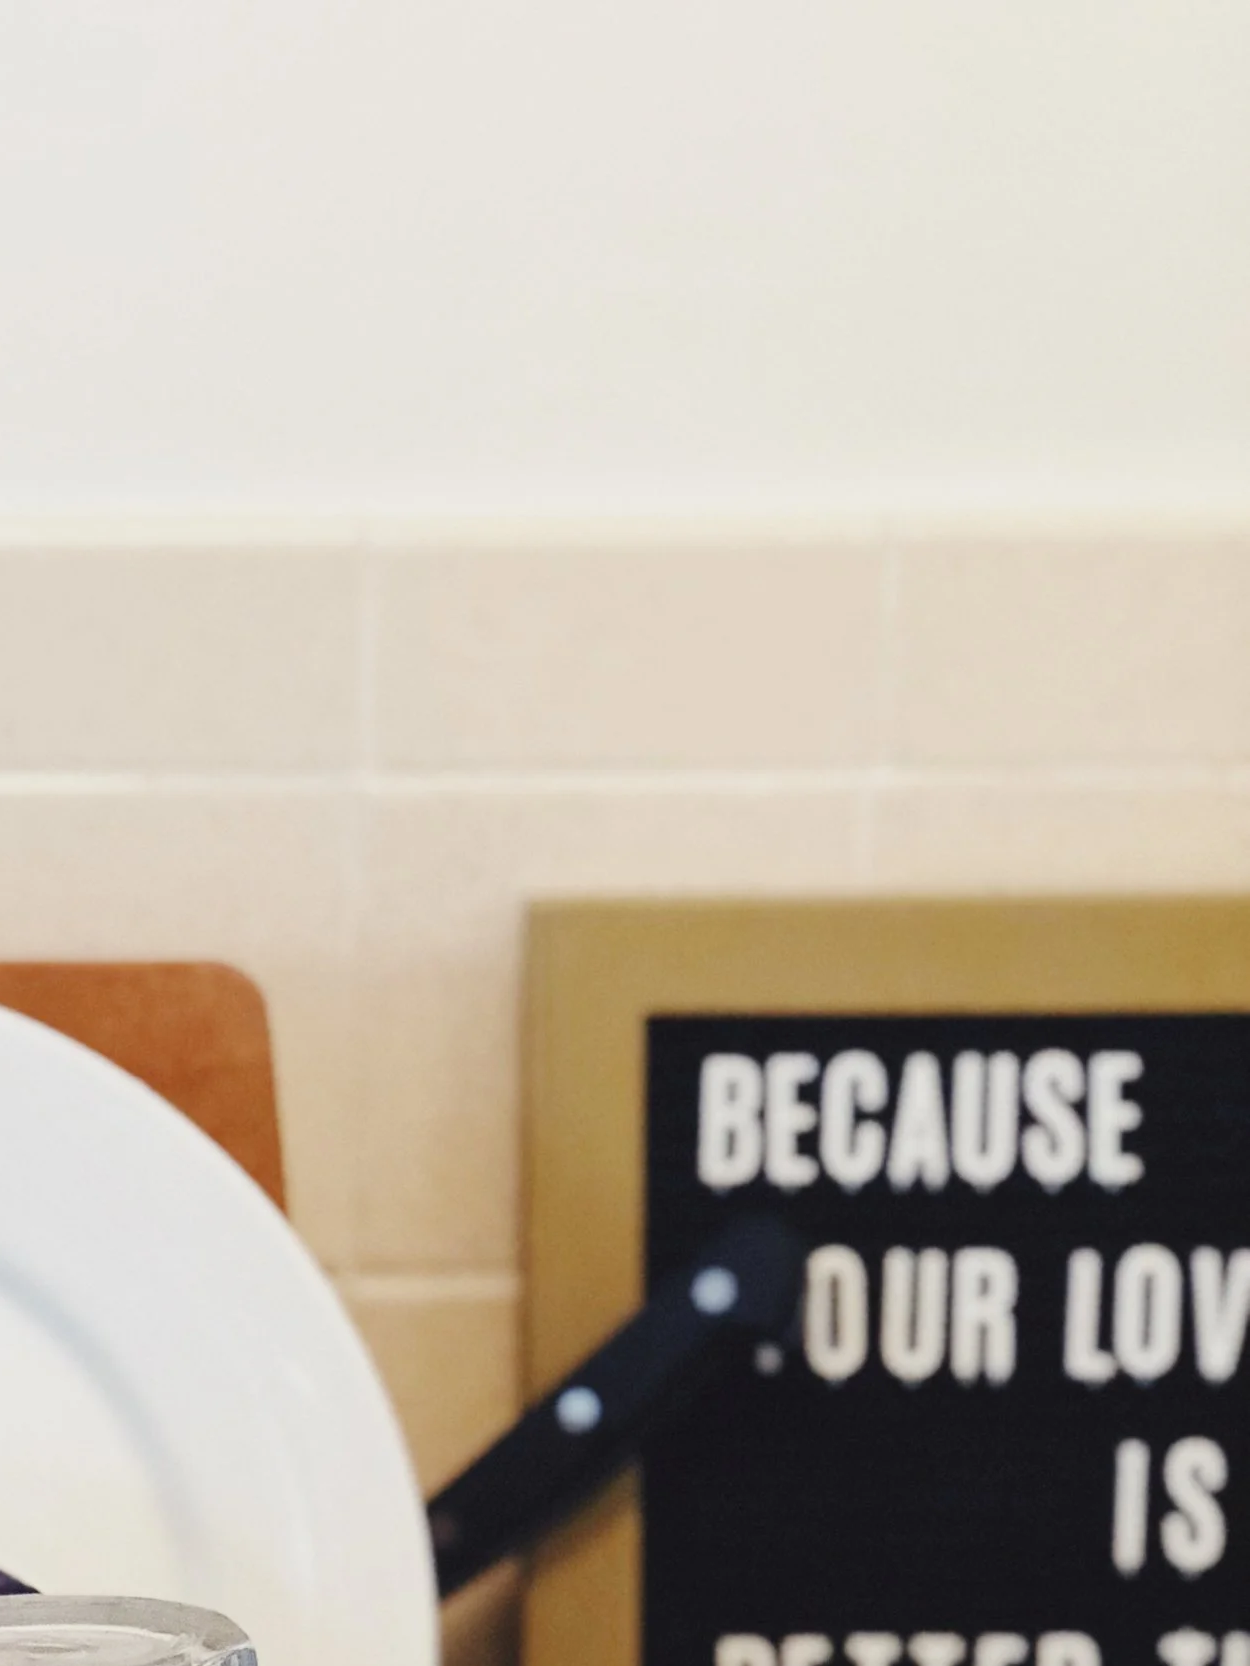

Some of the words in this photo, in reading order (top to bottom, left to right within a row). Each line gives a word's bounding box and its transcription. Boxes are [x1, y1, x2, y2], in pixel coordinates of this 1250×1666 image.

[696, 1048, 1144, 1189] BECAUSE
[752, 1243, 1018, 1384] OUR
[1062, 1243, 1250, 1386] LOV
[1112, 1435, 1228, 1575] IS
